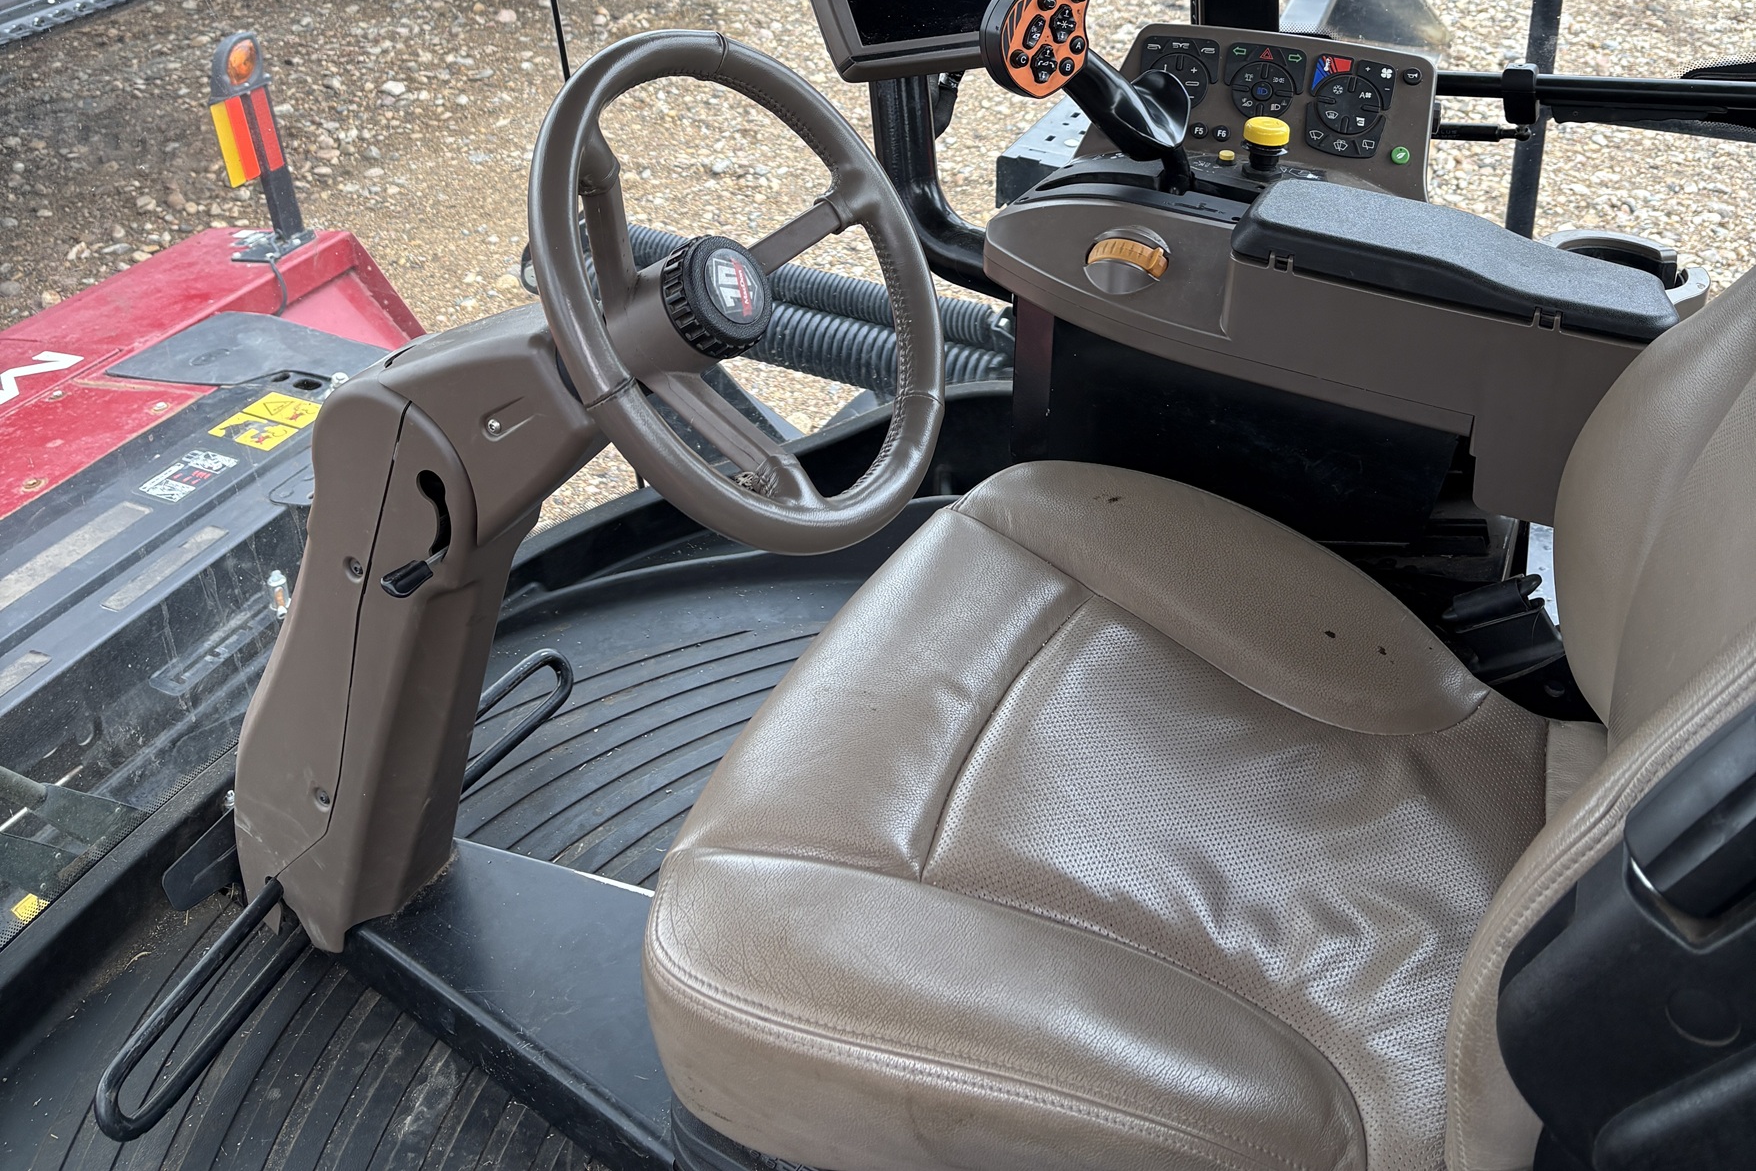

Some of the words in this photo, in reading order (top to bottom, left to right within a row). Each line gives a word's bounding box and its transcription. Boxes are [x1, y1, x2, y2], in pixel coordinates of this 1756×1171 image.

[1075, 42, 1082, 50] A
[1020, 56, 1027, 64] C
[1065, 63, 1071, 71] B
[1194, 126, 1204, 135] F5
[1217, 129, 1227, 138] F6
